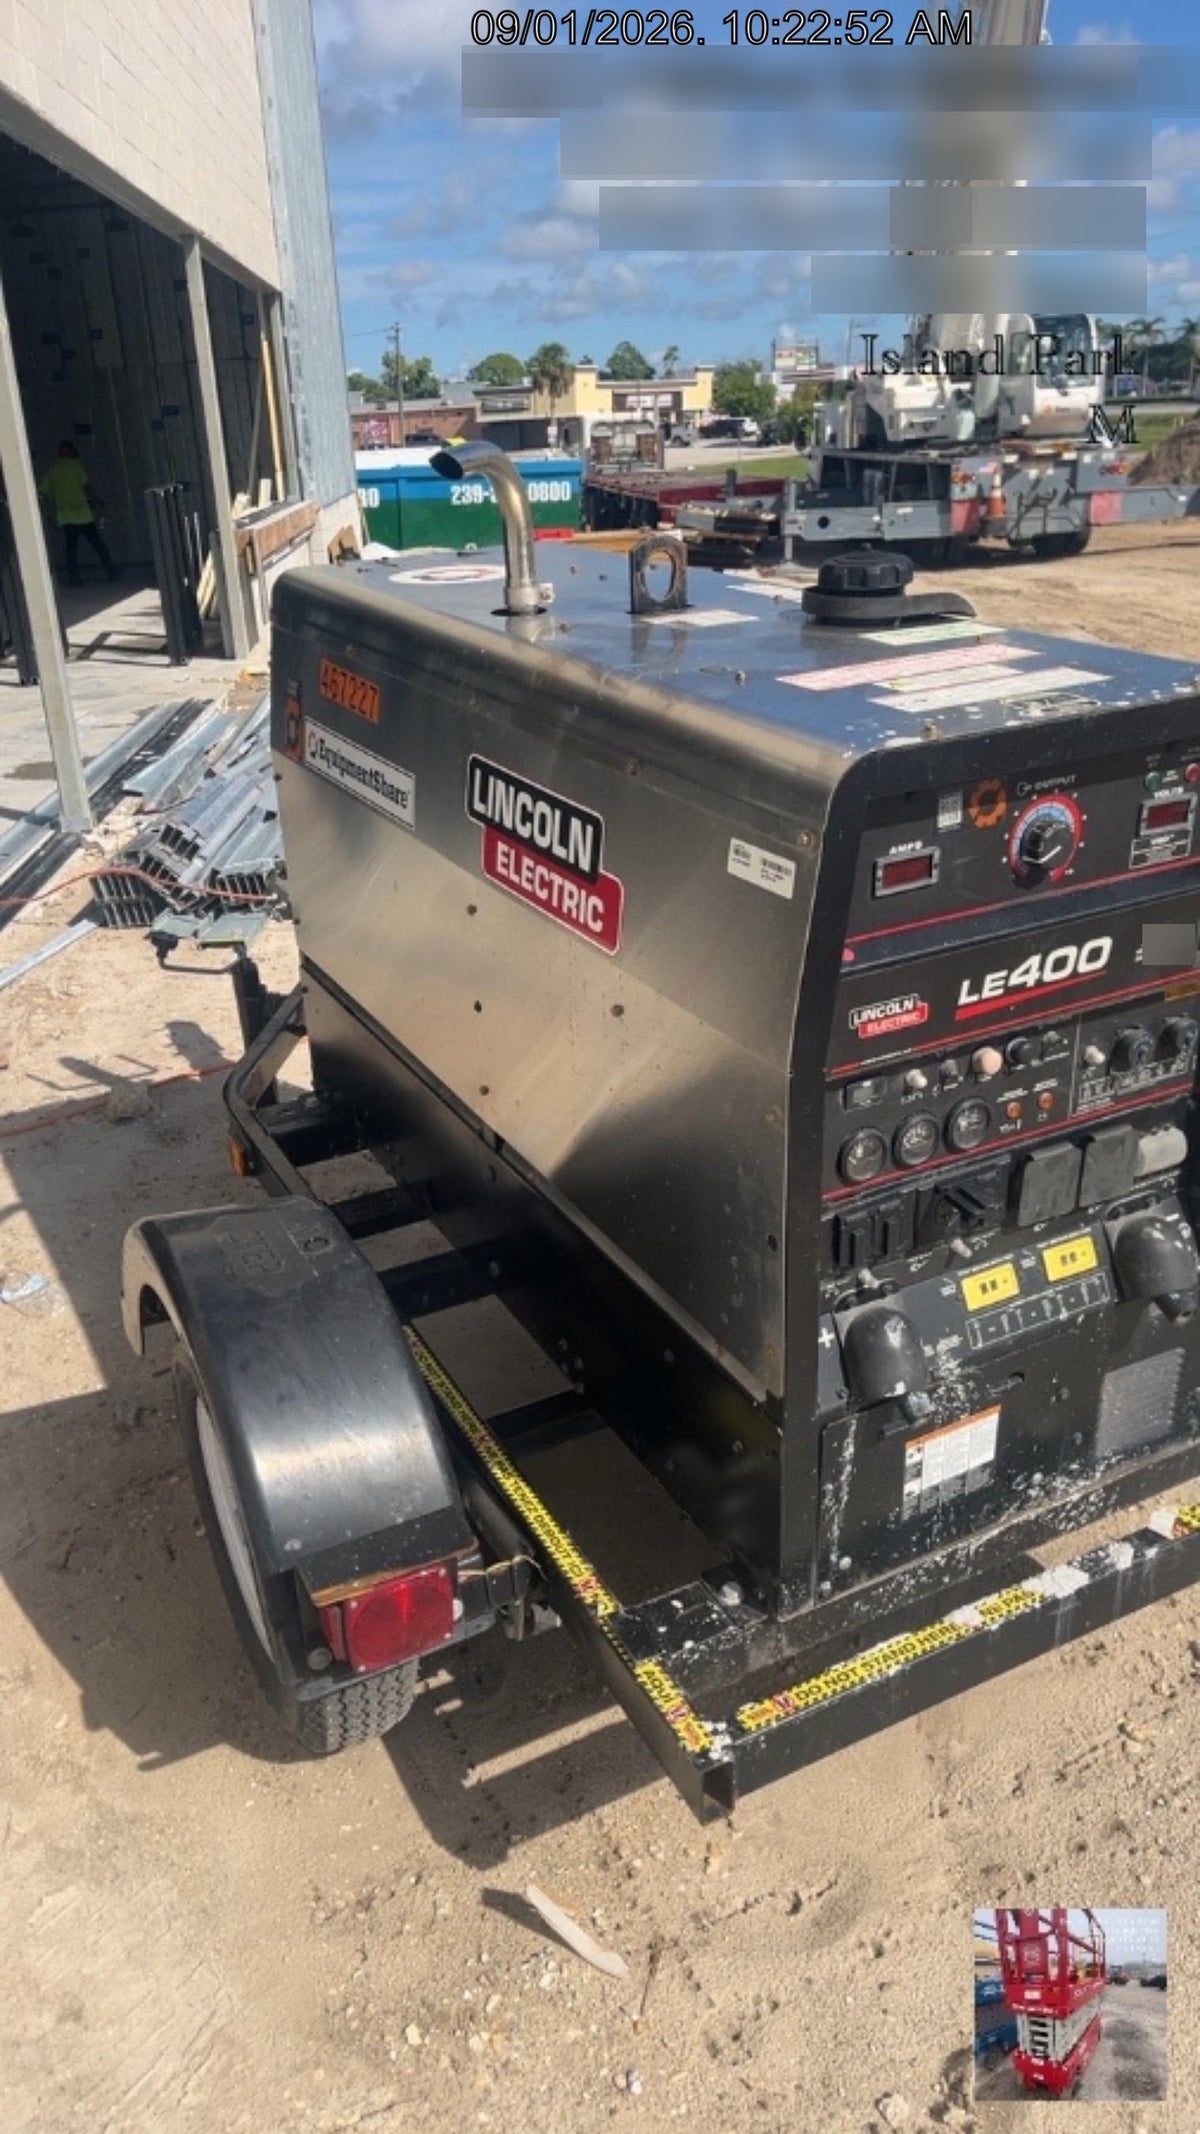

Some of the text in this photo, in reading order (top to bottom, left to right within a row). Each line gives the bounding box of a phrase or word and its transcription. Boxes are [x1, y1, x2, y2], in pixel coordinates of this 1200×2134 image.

[321, 664, 378, 720] 467227
[473, 767, 594, 873] LINCOLN
[496, 840, 605, 933] ELECTRIC
[957, 936, 1113, 1006] LE400
[853, 997, 915, 1025] LINCOLN
[794, 1684, 821, 1702] DO
[821, 1666, 860, 1690] NOT
